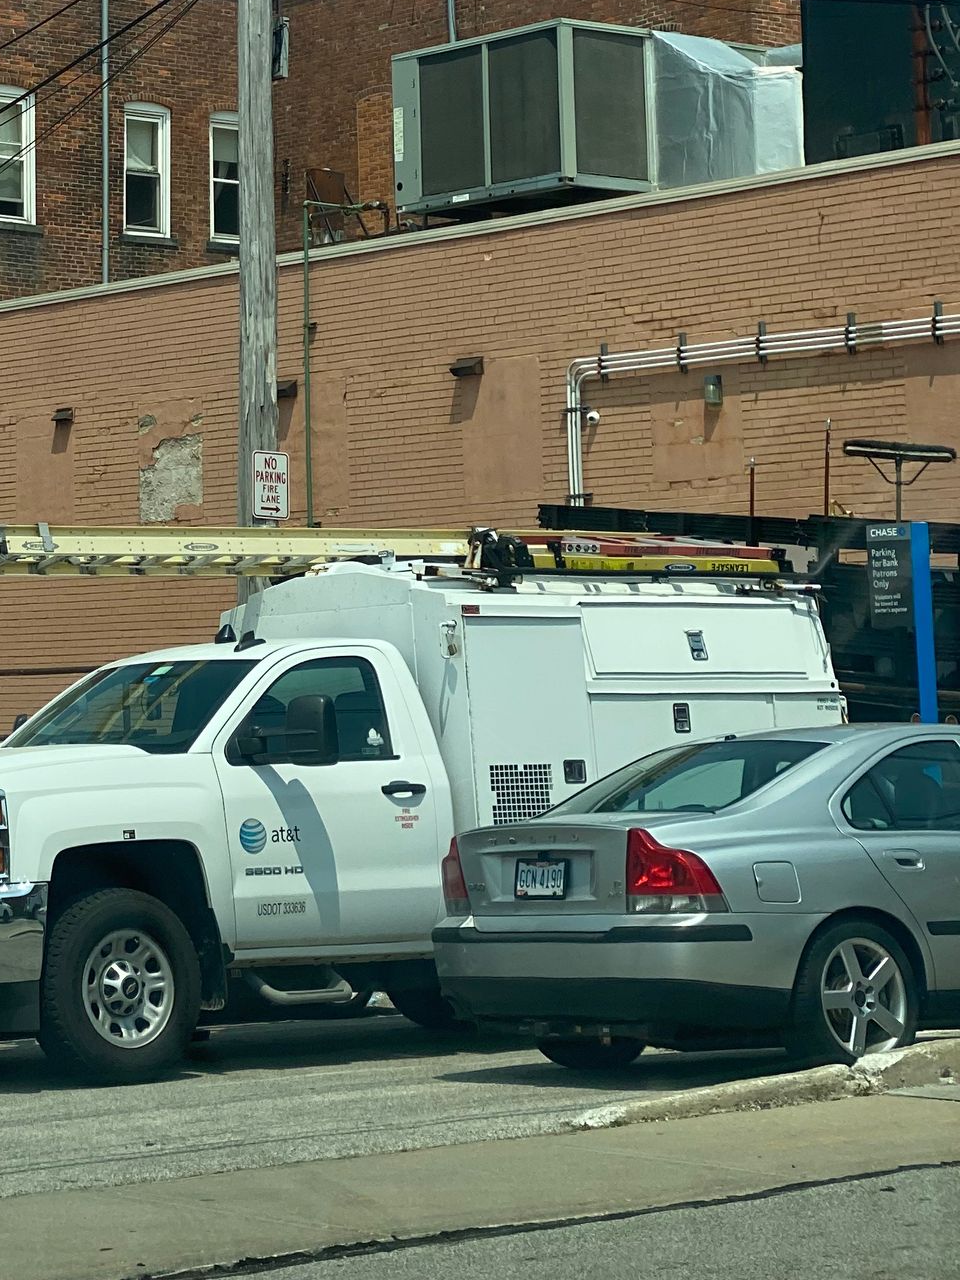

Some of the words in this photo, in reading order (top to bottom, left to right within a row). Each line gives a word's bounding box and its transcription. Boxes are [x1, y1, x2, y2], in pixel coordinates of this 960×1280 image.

[264, 457, 277, 470] NO
[255, 471, 286, 484] PARKING
[262, 484, 279, 494] FIRE
[261, 495, 281, 504] LANE
[870, 528, 898, 537] CHASE
[871, 548, 896, 558] Parking
[711, 563, 749, 572] LEANSAFE
[872, 559, 882, 568] for
[882, 558, 899, 567] Bank
[872, 569, 898, 578] Patrons
[873, 580, 890, 590] Only
[271, 825, 302, 843] at&t
[284, 865, 304, 875] HD
[520, 869, 538, 889] GCN
[540, 869, 562, 889] 4190
[257, 903, 282, 916] USDOT
